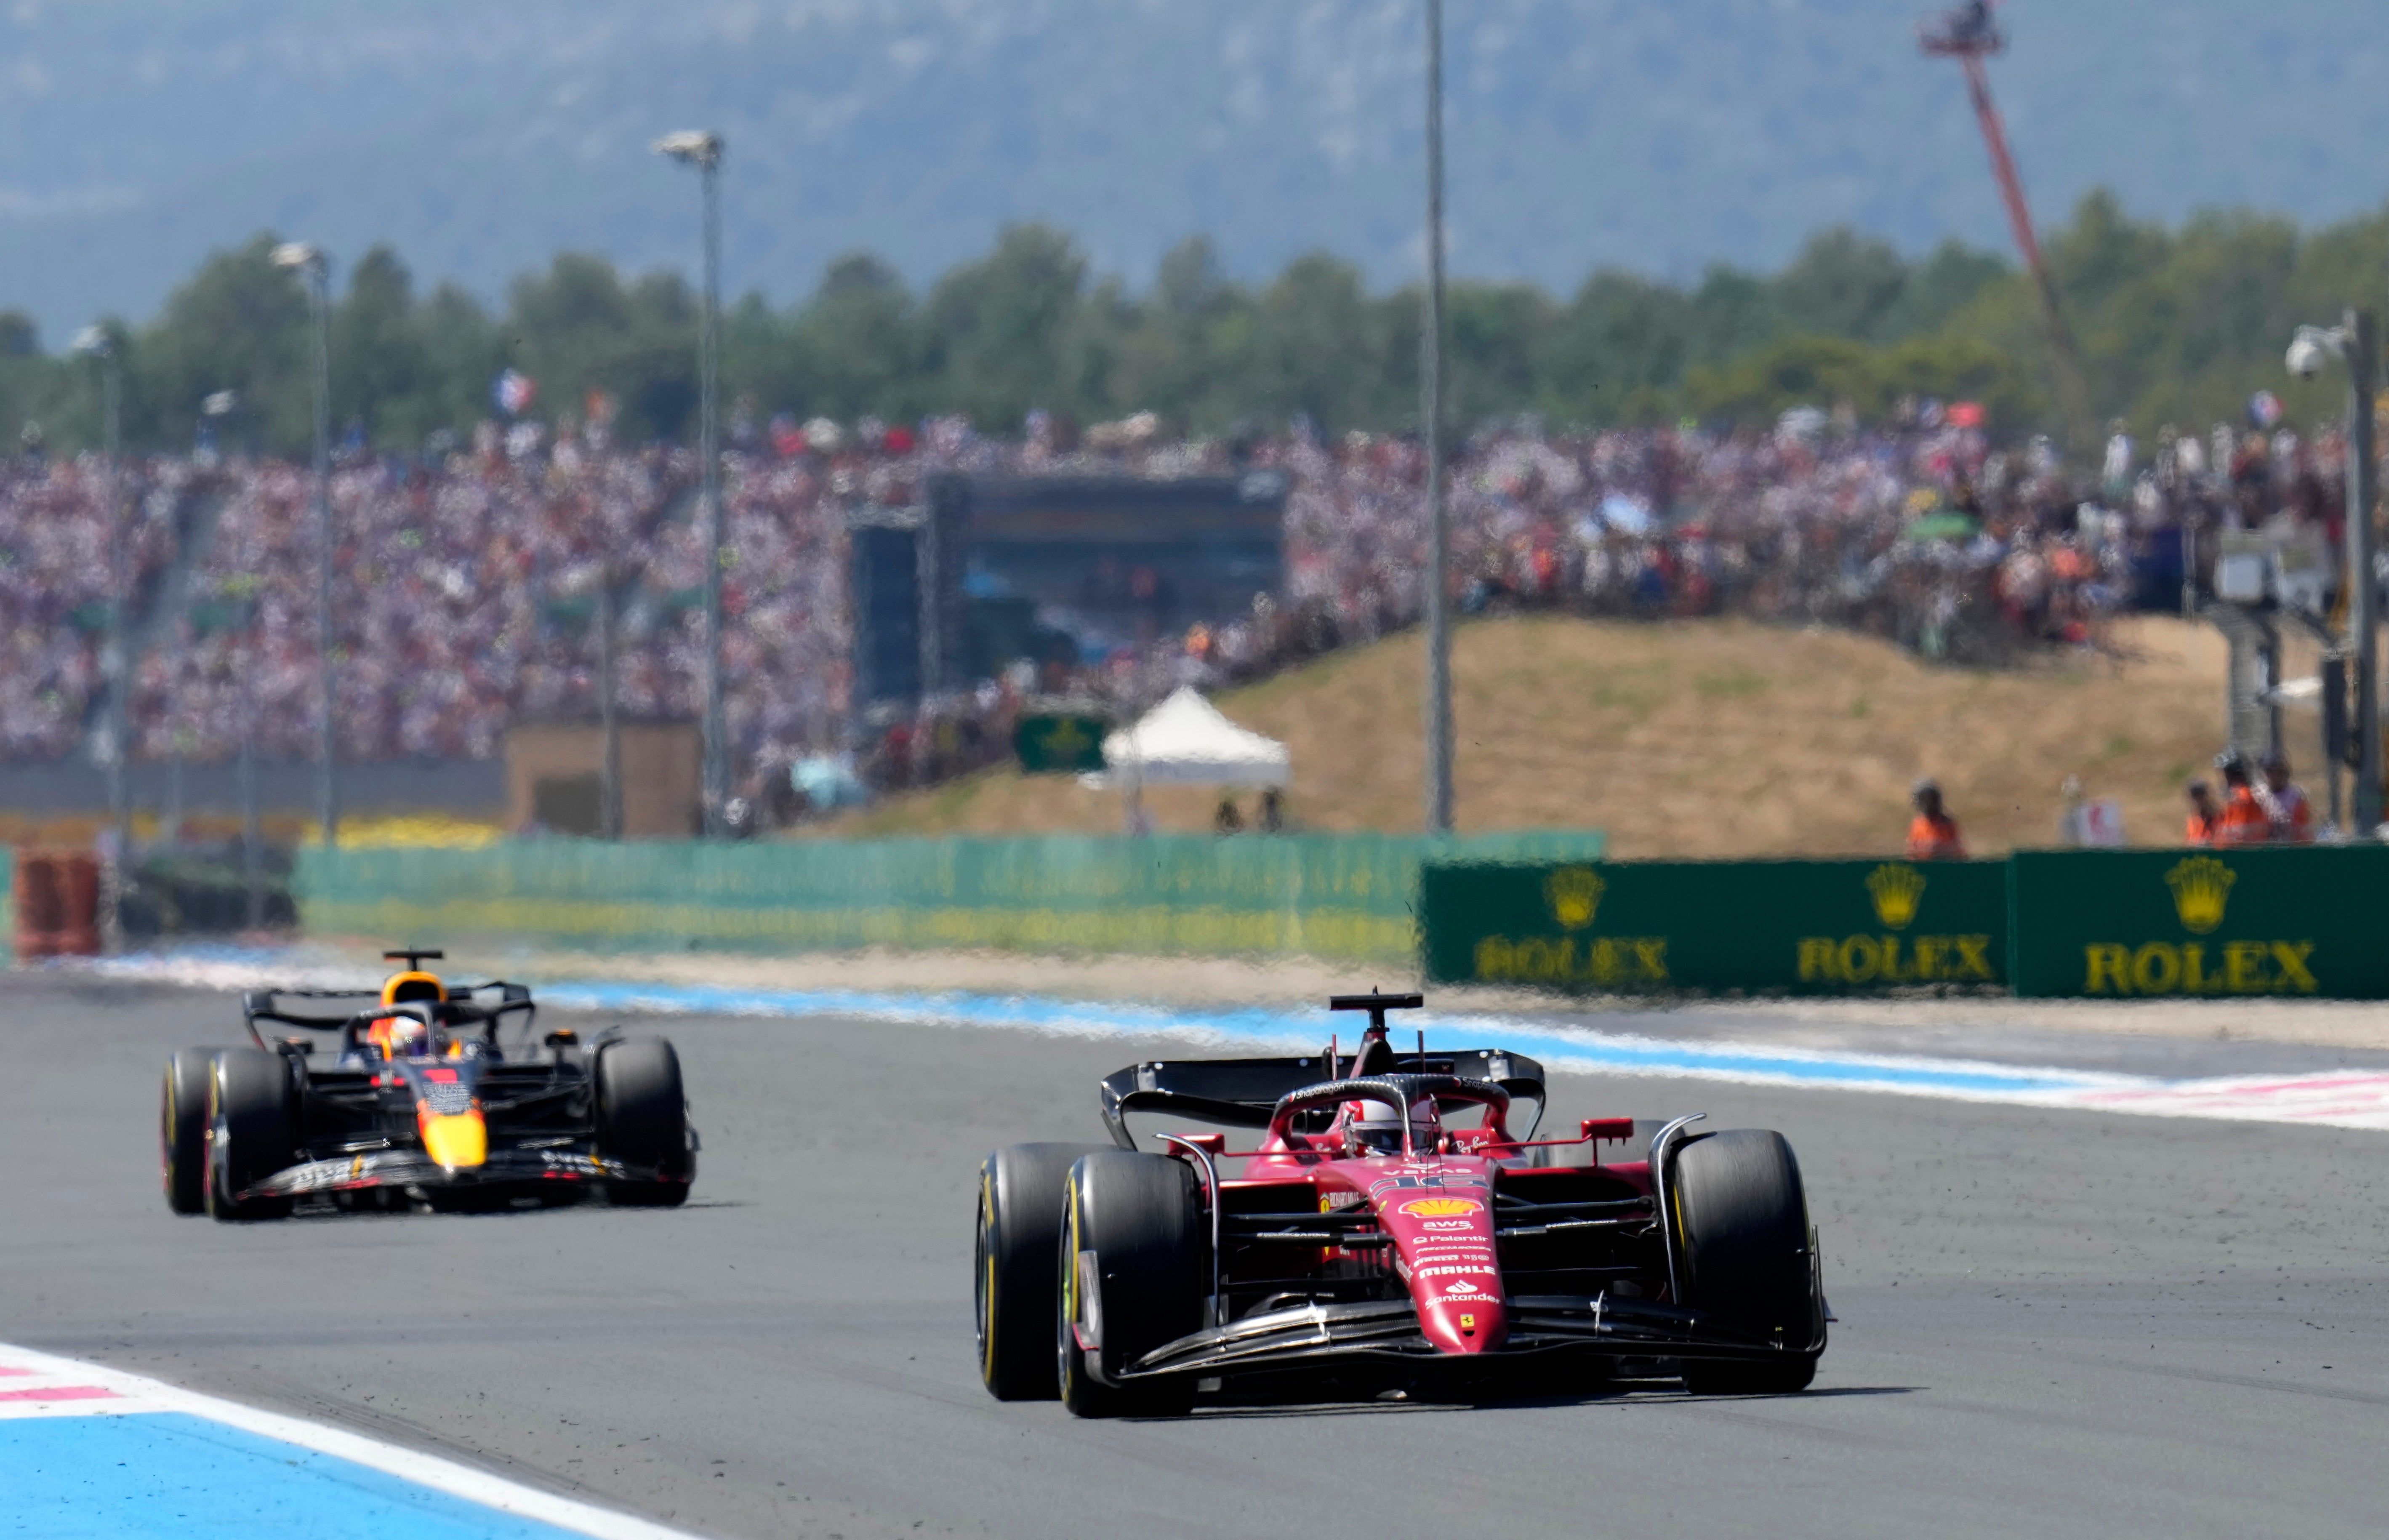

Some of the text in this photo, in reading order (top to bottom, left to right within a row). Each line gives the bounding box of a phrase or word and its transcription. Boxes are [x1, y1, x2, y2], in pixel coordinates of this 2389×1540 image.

[1797, 933, 1995, 983] ROLEX
[2083, 939, 2319, 995] ROLEX
[1296, 1084, 1345, 1100] Snapdragon
[1422, 1220, 1472, 1228] aws
[1418, 1265, 1496, 1280] MAHLE
[1425, 1292, 1502, 1311] Santander
